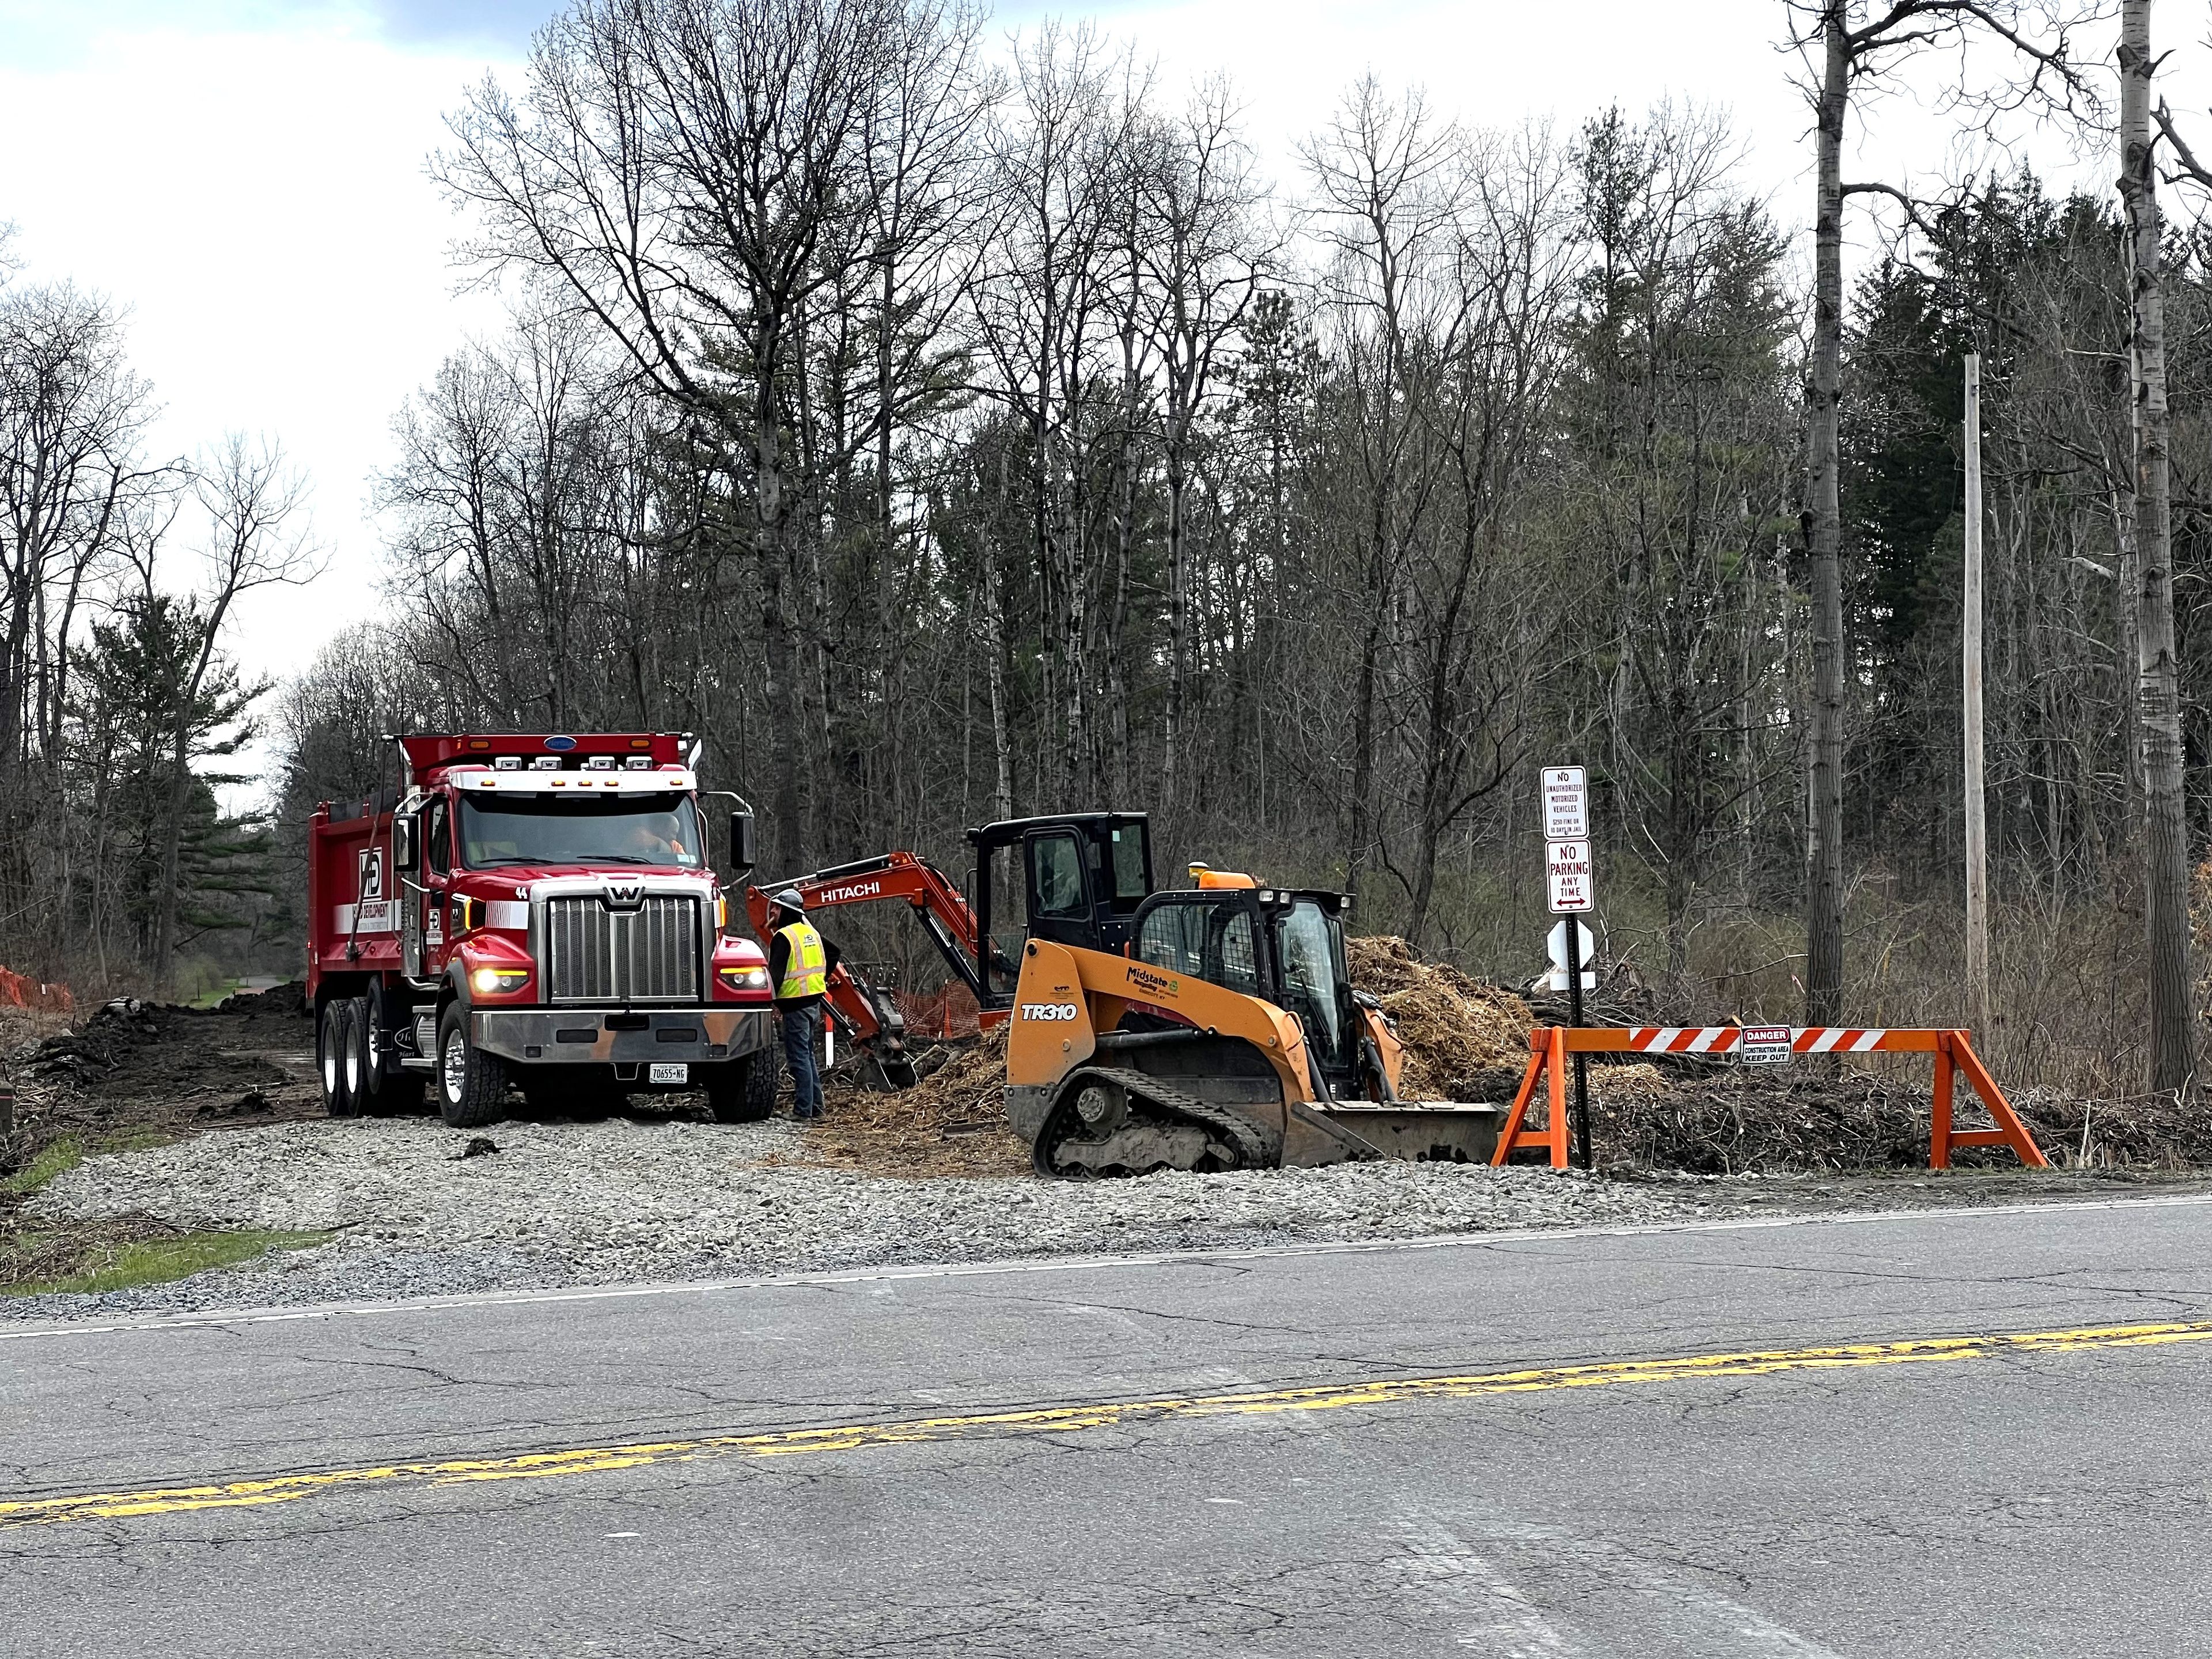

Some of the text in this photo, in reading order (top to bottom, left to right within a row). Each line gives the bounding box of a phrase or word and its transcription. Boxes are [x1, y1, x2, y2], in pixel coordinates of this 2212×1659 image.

[1558, 773, 1569, 782] NO
[1560, 847, 1576, 859] NO
[1551, 862, 1588, 876] PARKING
[1562, 877, 1578, 886] ANY
[821, 881, 880, 903] HITACHI
[1560, 888, 1581, 896] TIME
[1126, 966, 1168, 987] Midstate
[1021, 1003, 1078, 1021] TR310
[1747, 1031, 1786, 1040] DANGER
